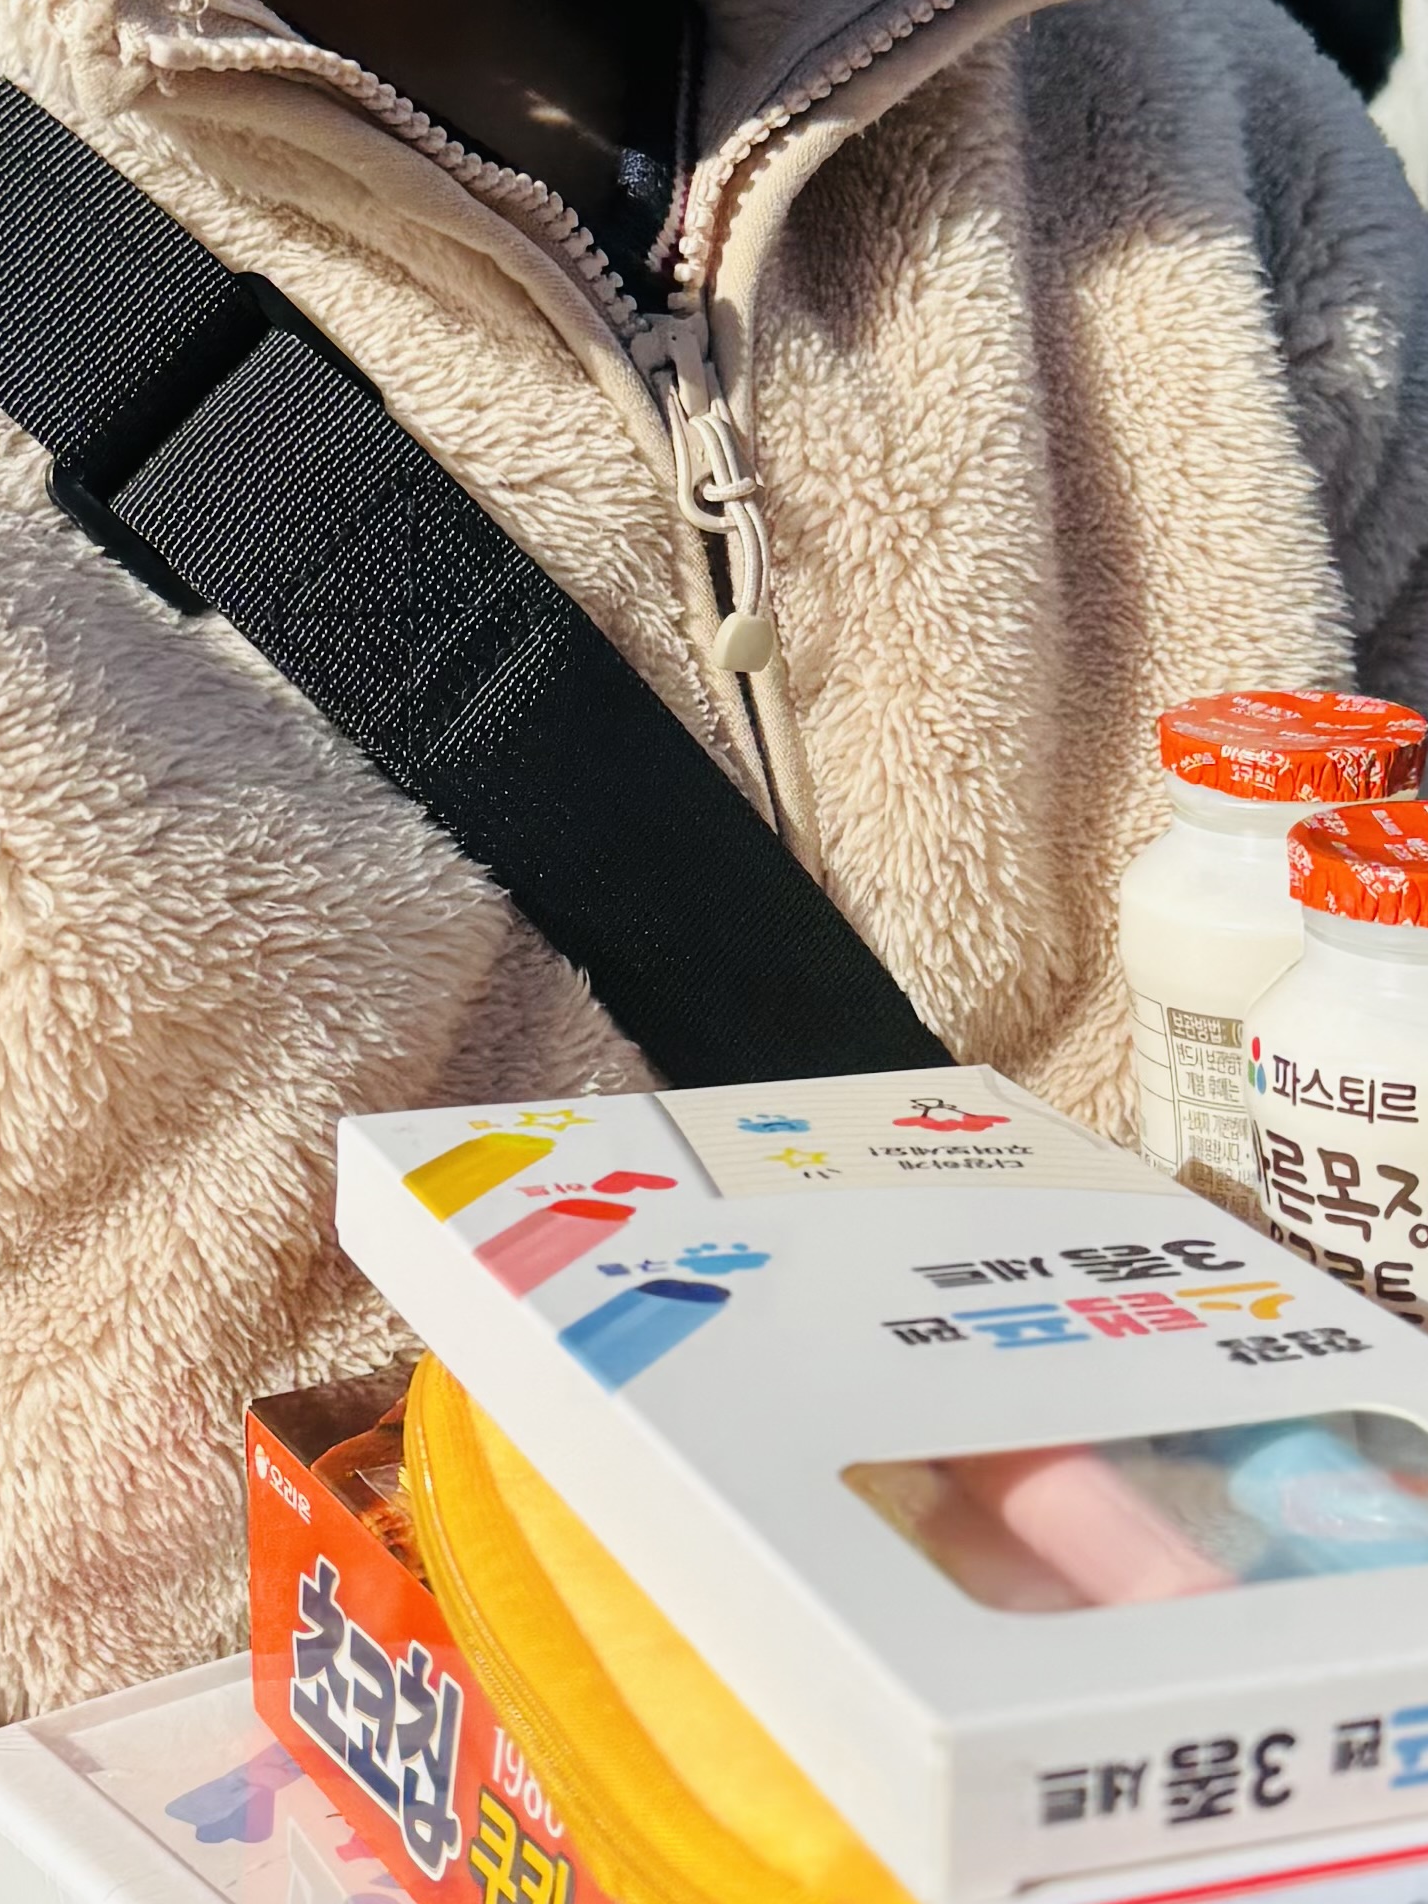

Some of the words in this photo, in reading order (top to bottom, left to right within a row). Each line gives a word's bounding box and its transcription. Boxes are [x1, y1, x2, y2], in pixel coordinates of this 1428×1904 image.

[1272, 1053, 1420, 1124] 파스퇴르
[911, 1255, 1054, 1290] 세트
[1059, 1238, 1247, 1283] 3종
[269, 1461, 313, 1526] 오리온
[290, 1552, 465, 1882] 초코칩
[1038, 1759, 1150, 1827] 세트
[1164, 1731, 1298, 1826] 3종
